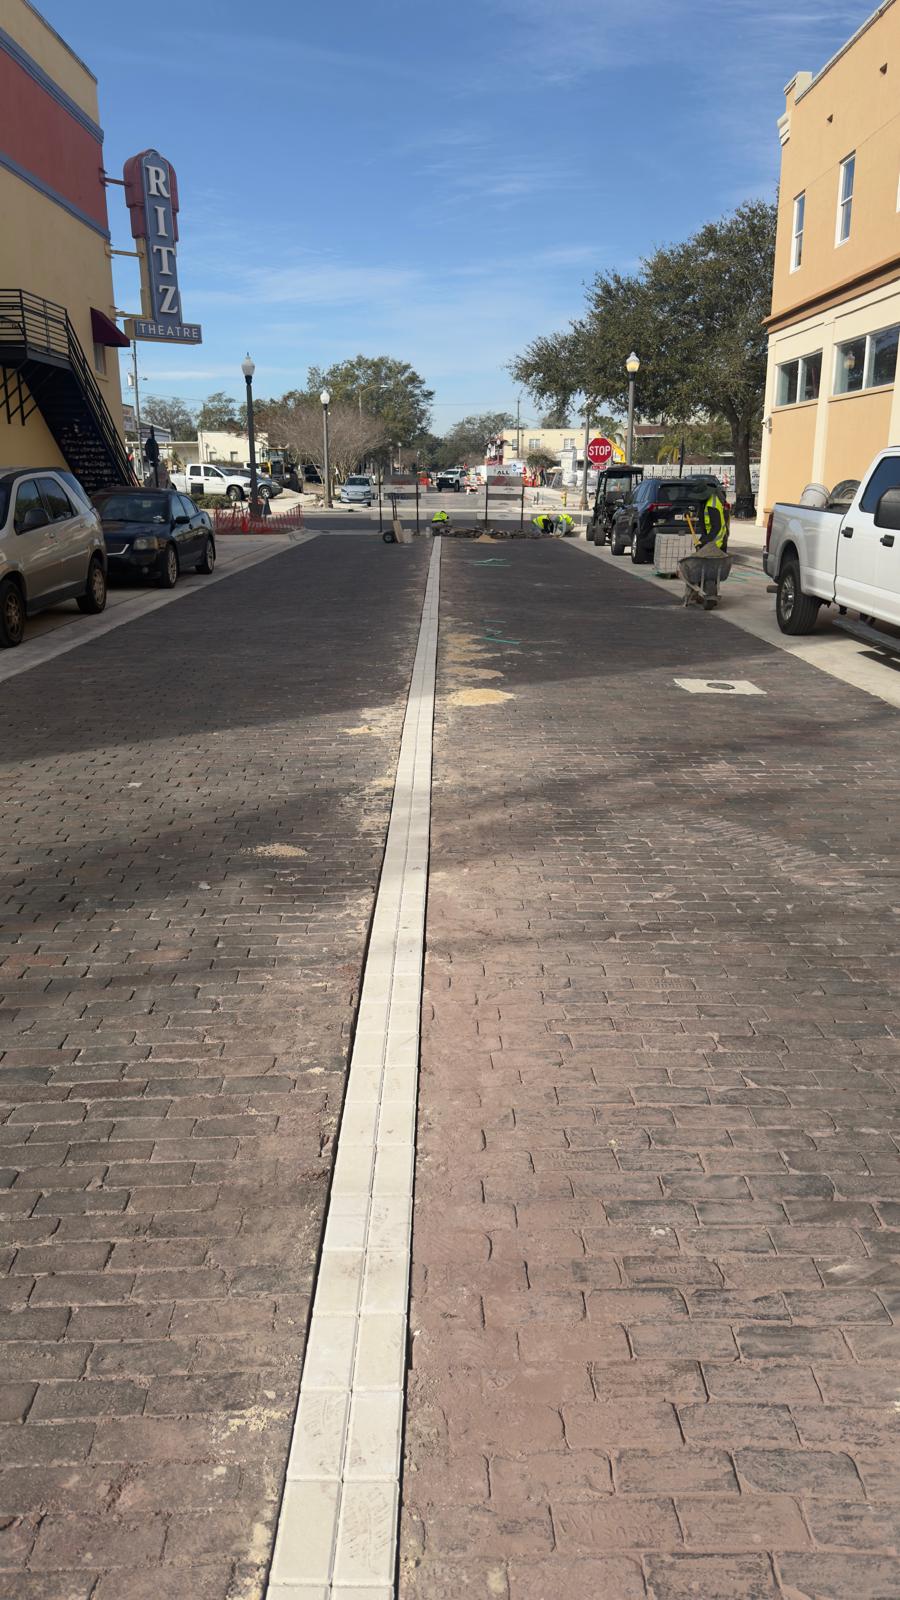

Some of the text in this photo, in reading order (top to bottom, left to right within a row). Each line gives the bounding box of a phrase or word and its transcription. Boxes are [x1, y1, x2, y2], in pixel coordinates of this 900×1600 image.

[146, 165, 178, 313] RITZ
[140, 323, 199, 339] THEATRE
[588, 446, 611, 456] STOP
